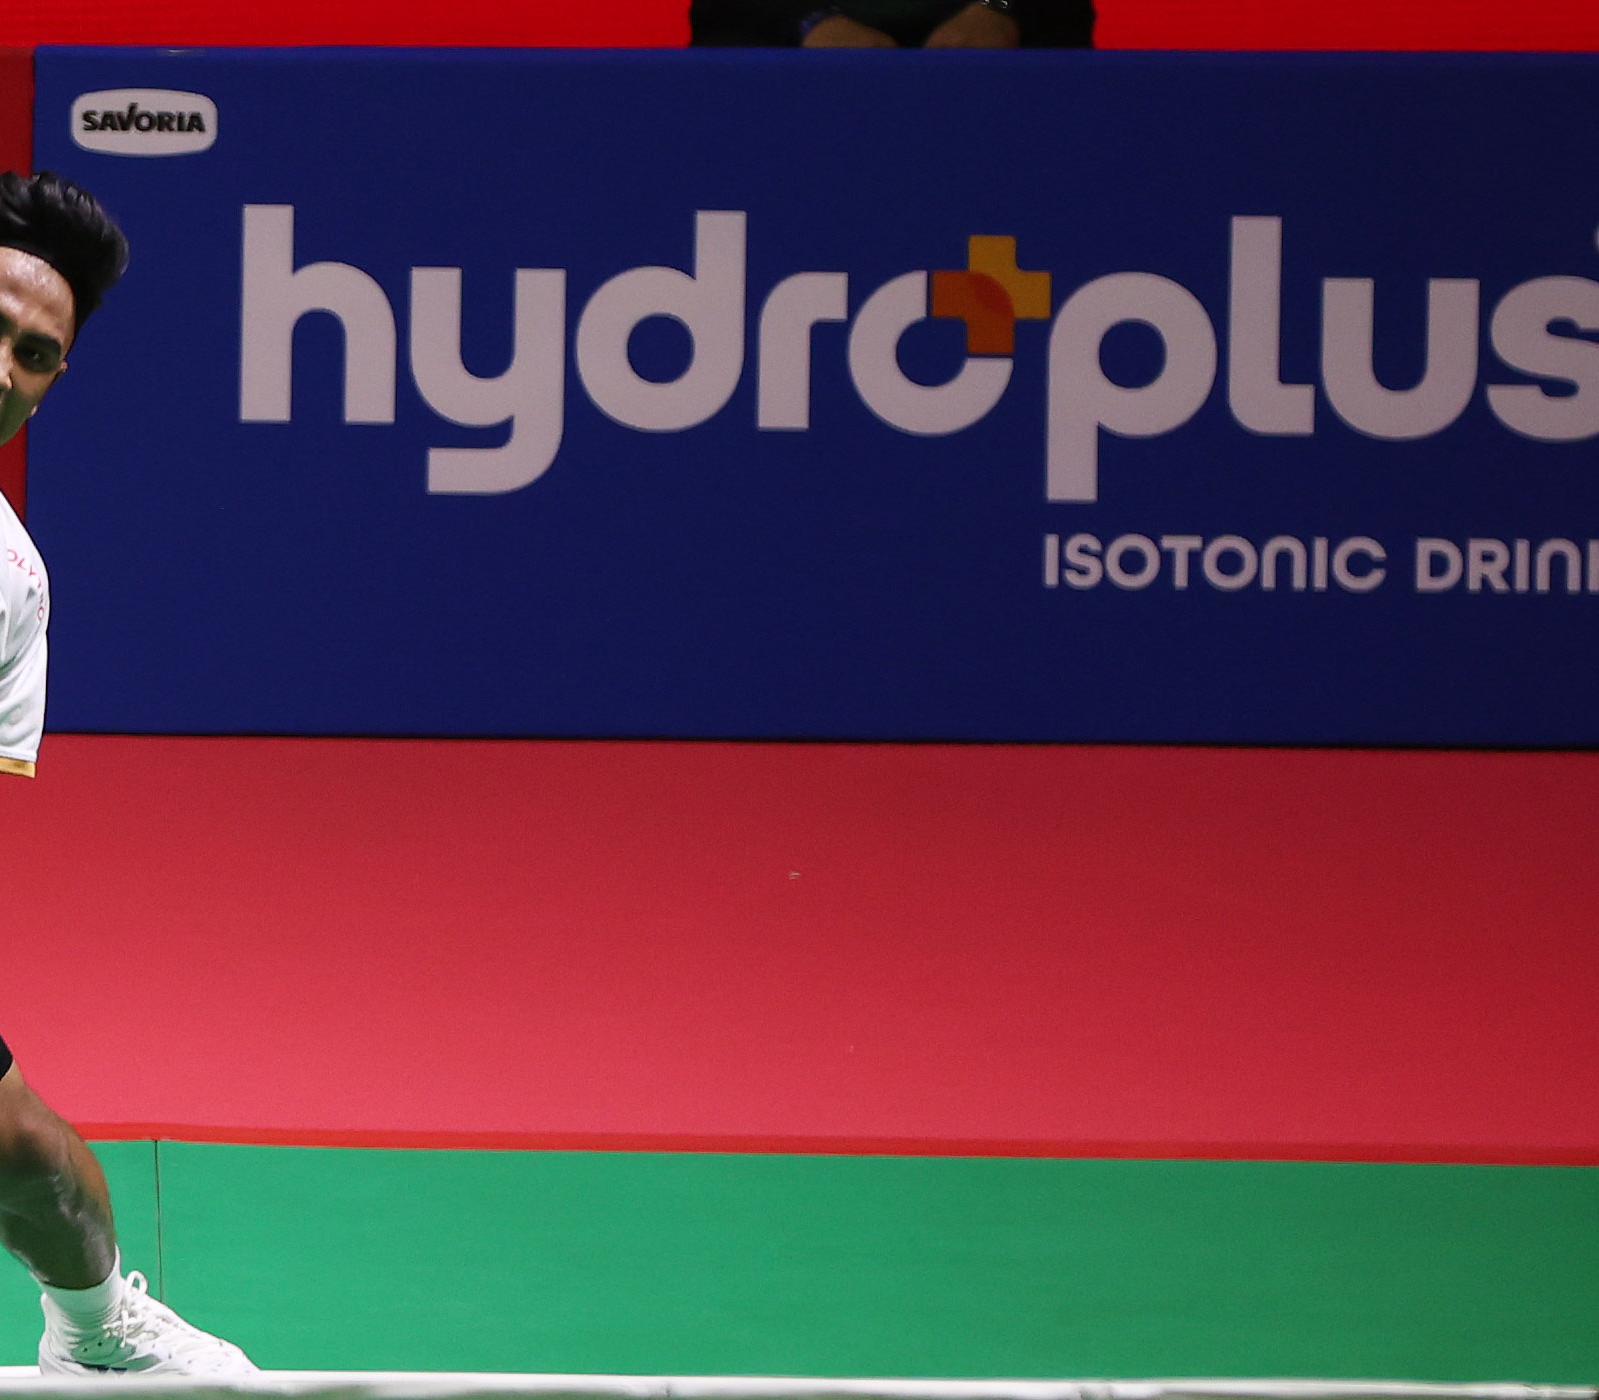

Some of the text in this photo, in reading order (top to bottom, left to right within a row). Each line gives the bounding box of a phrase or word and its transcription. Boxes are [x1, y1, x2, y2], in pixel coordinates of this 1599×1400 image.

[82, 102, 206, 132] SAVORIA
[240, 204, 1599, 503] hydroplus
[1044, 534, 1386, 592] ISOTONIC
